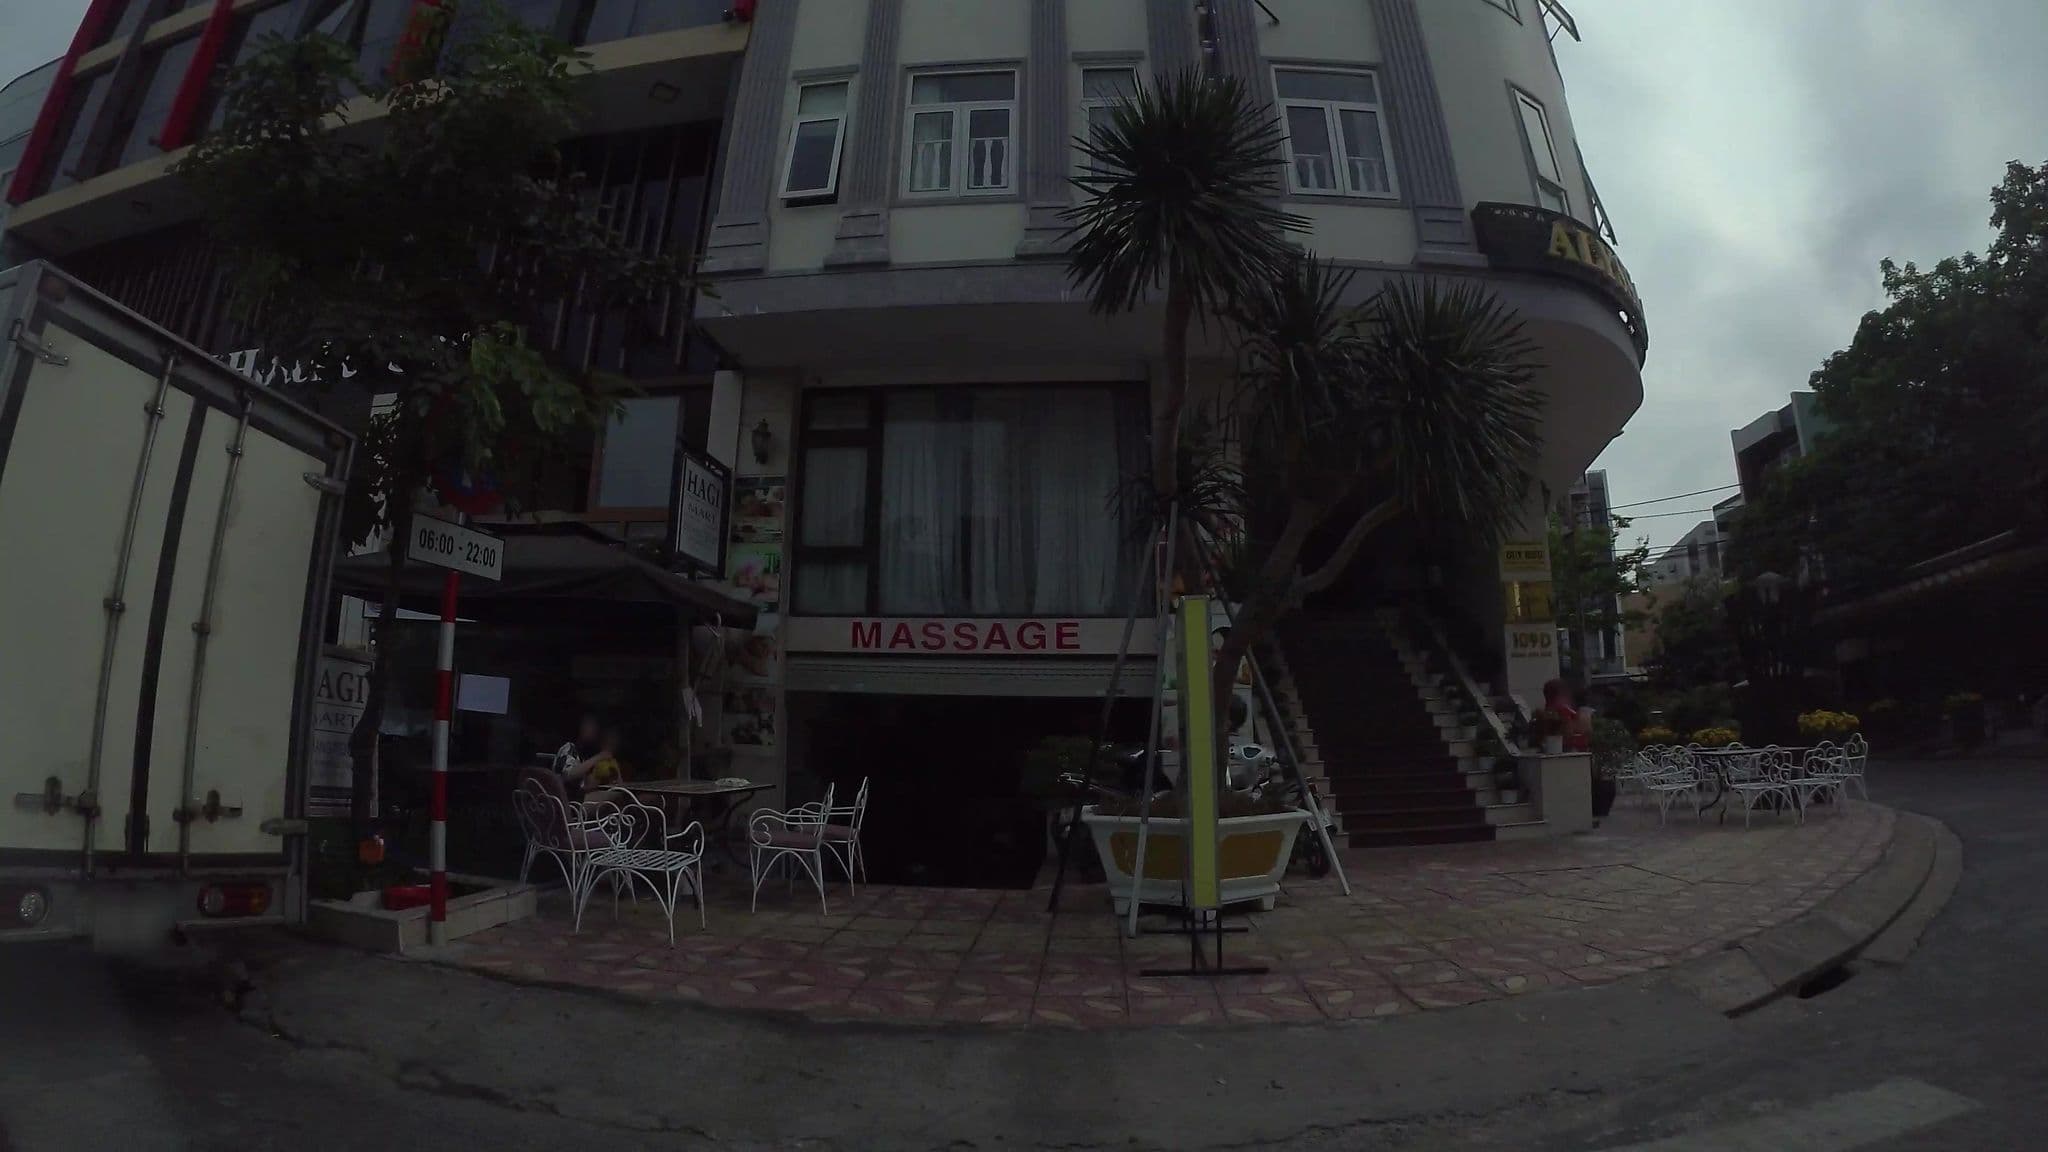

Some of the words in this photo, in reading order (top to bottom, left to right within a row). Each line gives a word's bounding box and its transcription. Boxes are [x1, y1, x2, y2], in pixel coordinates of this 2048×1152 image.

[687, 470, 720, 508] HAGI
[419, 528, 454, 555] 06:00
[466, 541, 496, 567] 22:00
[852, 621, 1081, 650] MASSAGE
[314, 669, 365, 704] AGI
